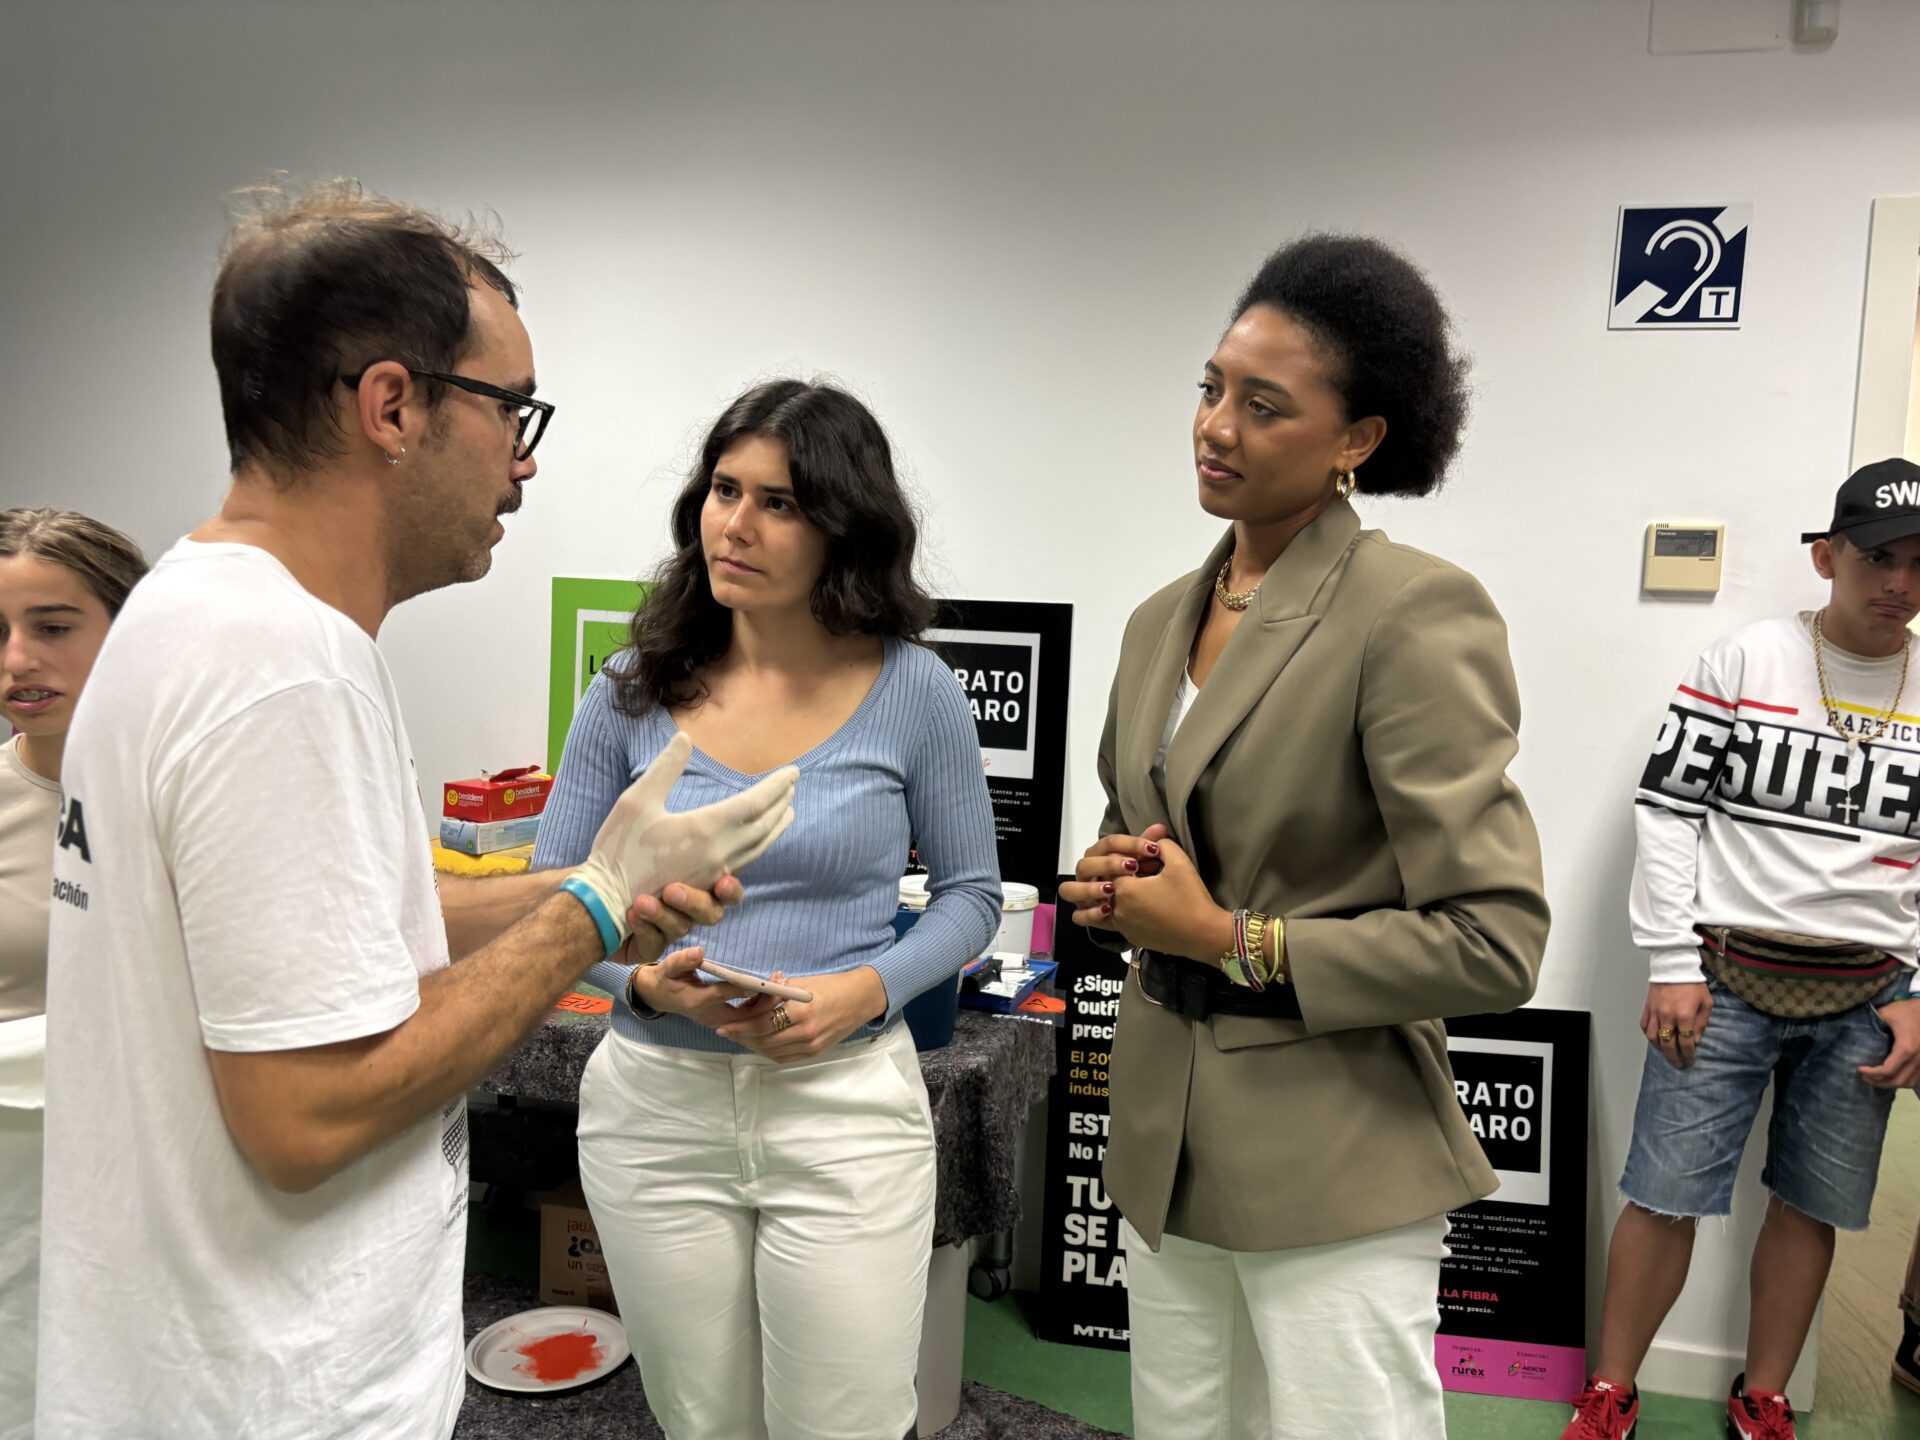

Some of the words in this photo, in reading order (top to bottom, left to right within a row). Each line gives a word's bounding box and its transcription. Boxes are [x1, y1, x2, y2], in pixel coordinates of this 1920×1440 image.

[1708, 291, 1730, 316] T
[954, 669, 1024, 694] RATO
[969, 698, 1020, 723] ARO
[1720, 720, 1920, 836] SUPE
[58, 793, 92, 864] A
[1074, 974, 1124, 996] ¿Sigu
[1071, 1050, 1084, 1063] El
[1088, 1052, 1111, 1066] 20
[1070, 1067, 1088, 1079] de
[1093, 1069, 1110, 1081] to
[1069, 1082, 1109, 1097] indus
[1454, 1080, 1535, 1109] RATO
[1069, 1112, 1110, 1137] EST
[1469, 1113, 1531, 1142] ARO
[1069, 1142, 1093, 1160] No
[1066, 1175, 1112, 1210] TU
[1063, 1213, 1108, 1248] SE
[1062, 1250, 1129, 1288] PLA
[1507, 1258, 1539, 1266] jornadas
[1443, 1288, 1459, 1298] LA
[1462, 1290, 1499, 1302] FIBRA
[1466, 1306, 1495, 1314] precio.
[1452, 1366, 1485, 1377] rurex
